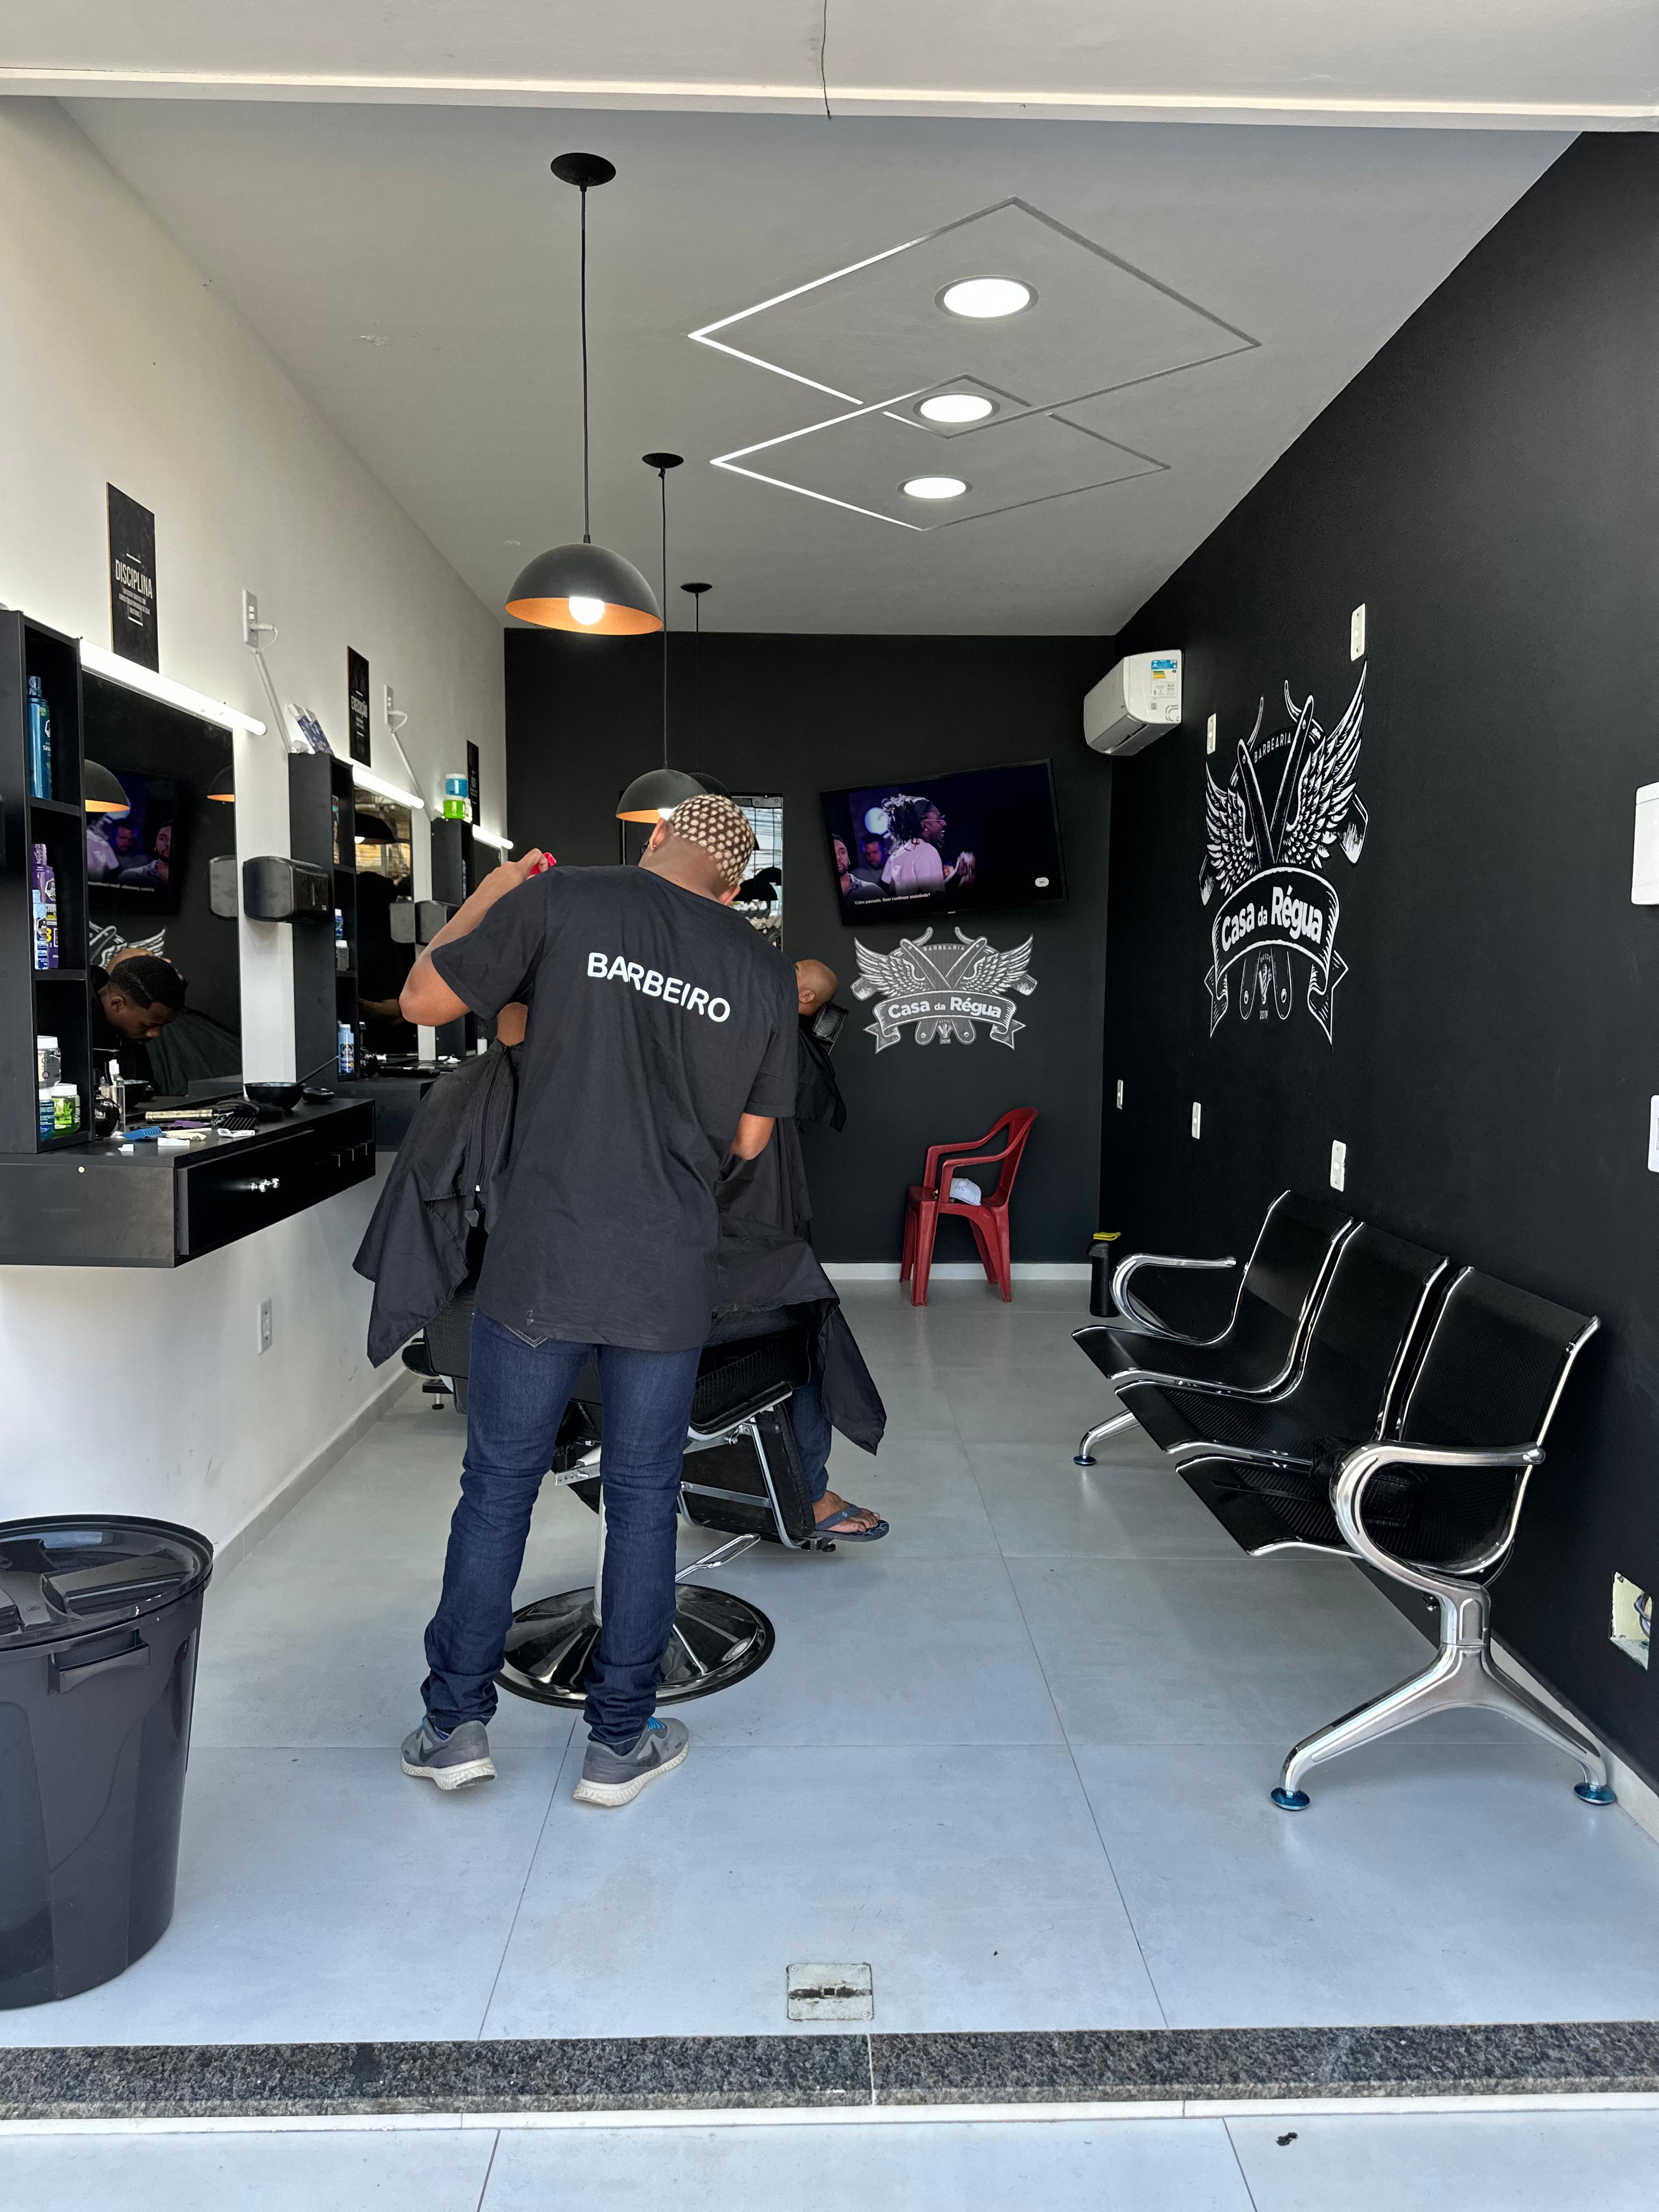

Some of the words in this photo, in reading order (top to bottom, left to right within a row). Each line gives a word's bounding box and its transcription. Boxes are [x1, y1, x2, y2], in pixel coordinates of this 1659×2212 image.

[115, 558, 153, 600] DISCIPLINA
[1254, 731, 1291, 763] BARBEARIA
[1221, 902, 1255, 952] Casa
[1257, 905, 1268, 927] da
[1271, 884, 1323, 944] Régua
[588, 952, 731, 1022] BARBEIRO
[888, 1000, 930, 1018] Casa
[934, 1002, 946, 1011] da
[950, 997, 1002, 1018] Régua
